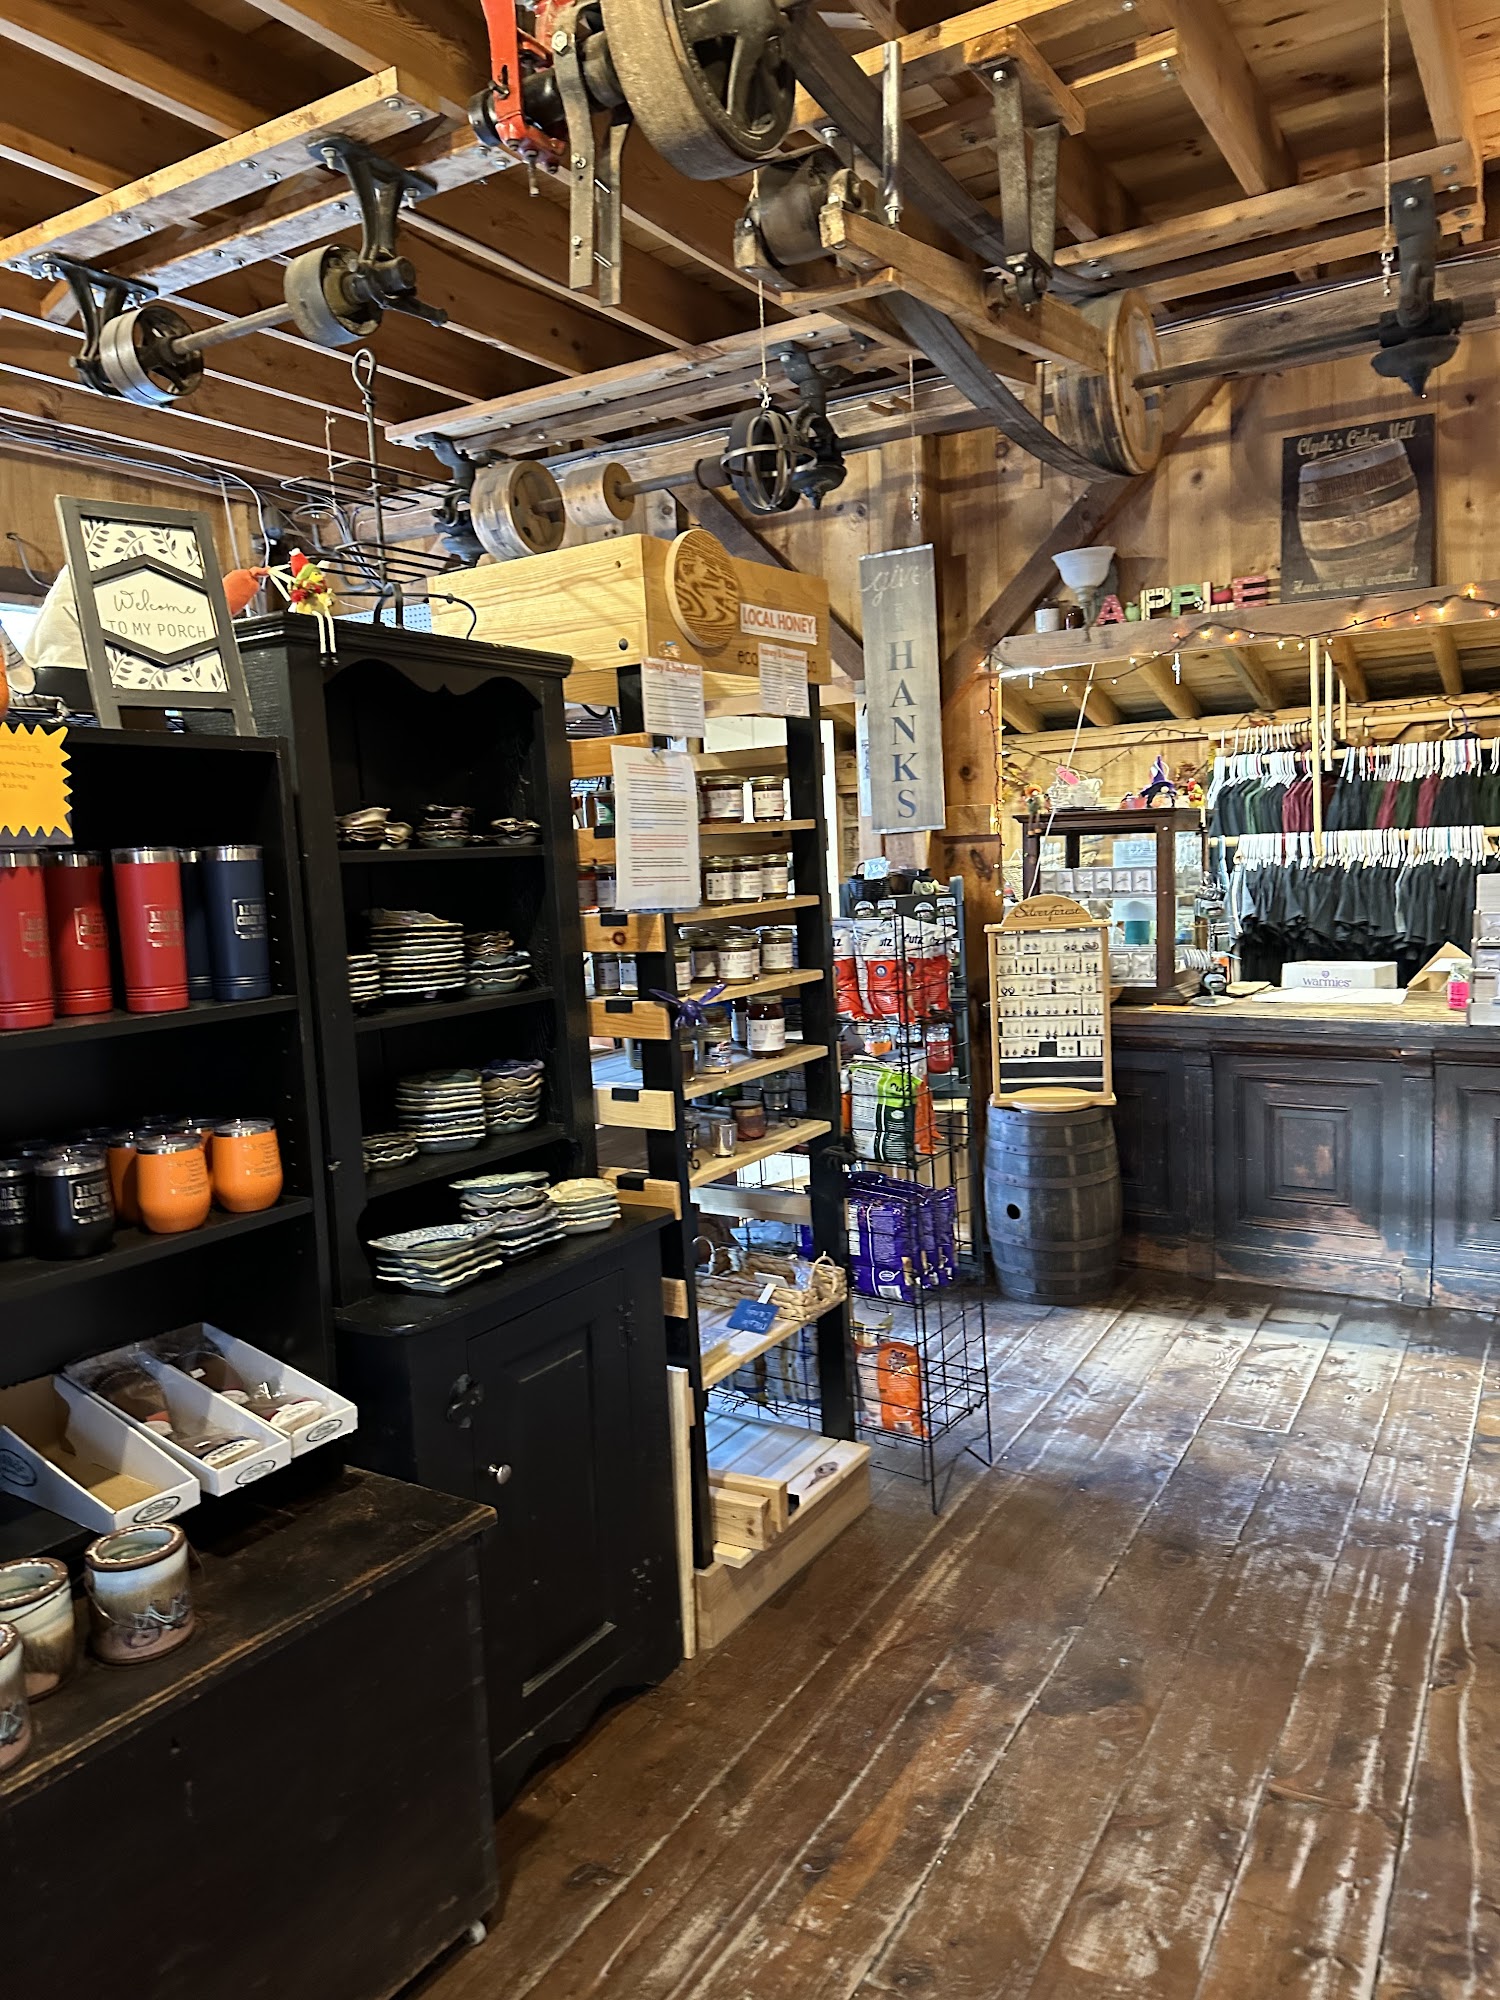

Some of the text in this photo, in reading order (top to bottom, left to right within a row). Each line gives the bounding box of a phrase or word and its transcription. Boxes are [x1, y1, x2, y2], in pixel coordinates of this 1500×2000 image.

[1297, 434, 1343, 459] Clyde's
[113, 588, 197, 614] Welcome
[1096, 575, 1268, 627] APPLE
[106, 620, 207, 638] TO MY PORCH
[742, 606, 814, 635] LOCAL HONEY
[1302, 977, 1350, 988] warmies
